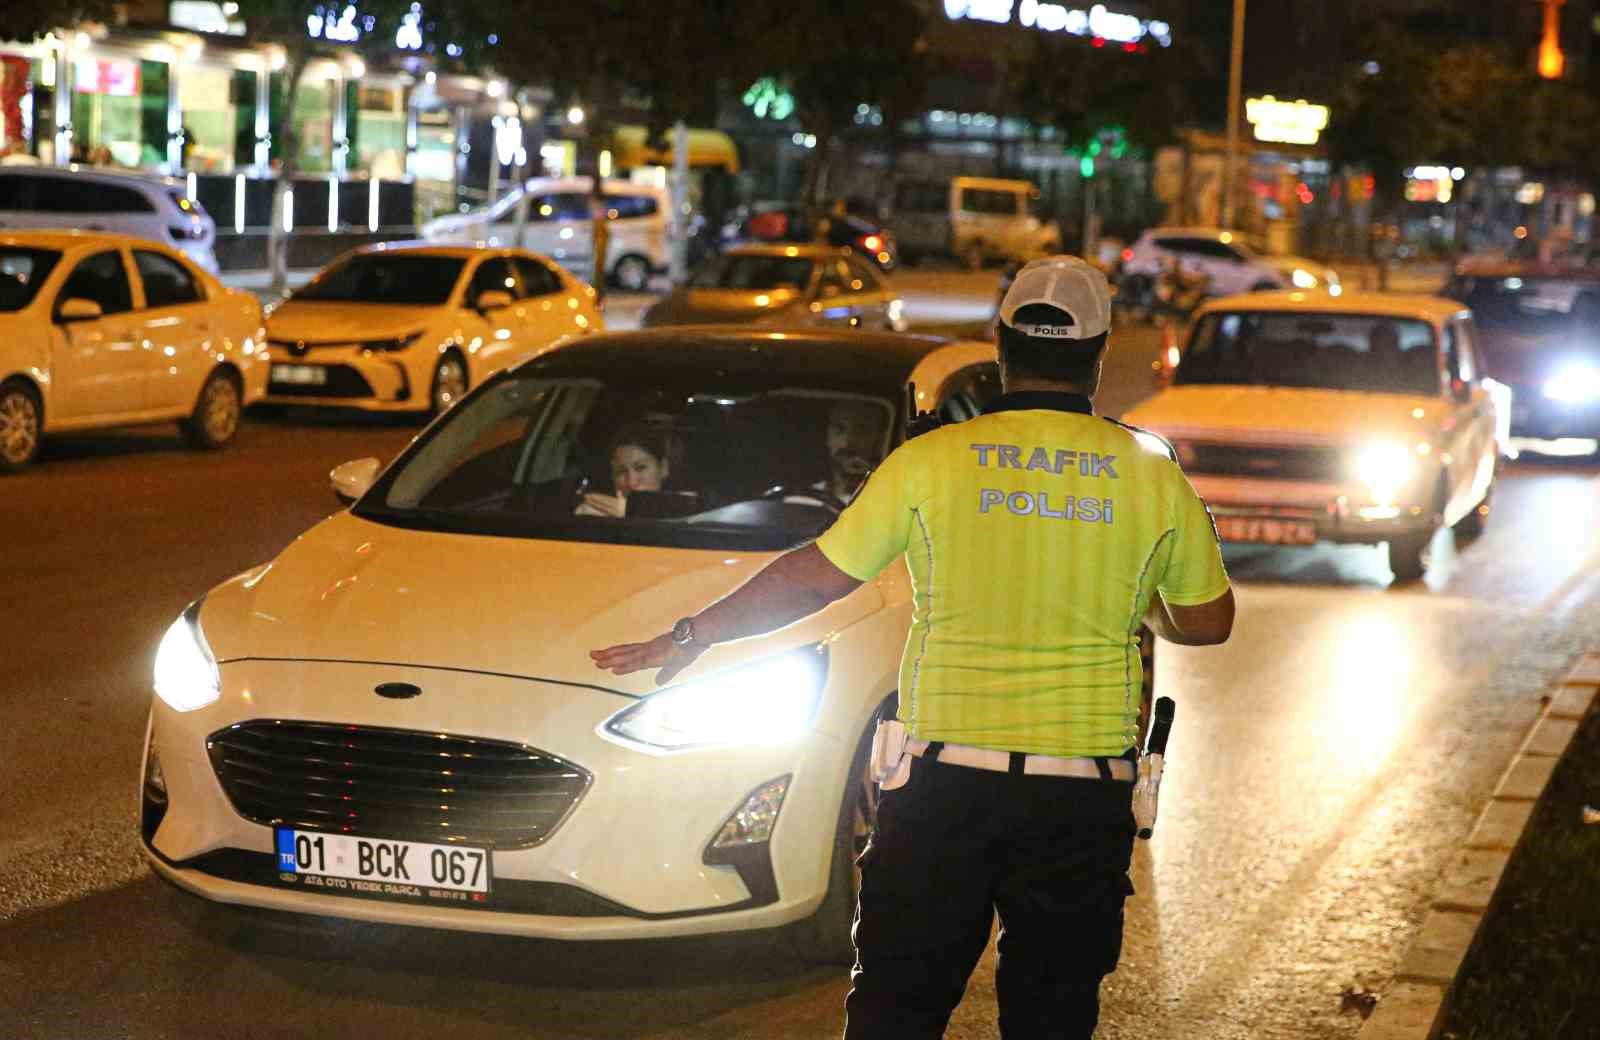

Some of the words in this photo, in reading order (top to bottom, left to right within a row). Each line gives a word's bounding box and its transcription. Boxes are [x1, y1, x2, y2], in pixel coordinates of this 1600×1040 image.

[280, 852, 295, 865] TR
[295, 835, 326, 871] 01
[357, 841, 410, 880] BCK
[431, 848, 484, 887] 067
[303, 875, 324, 887] ATA
[326, 877, 348, 889] OTO
